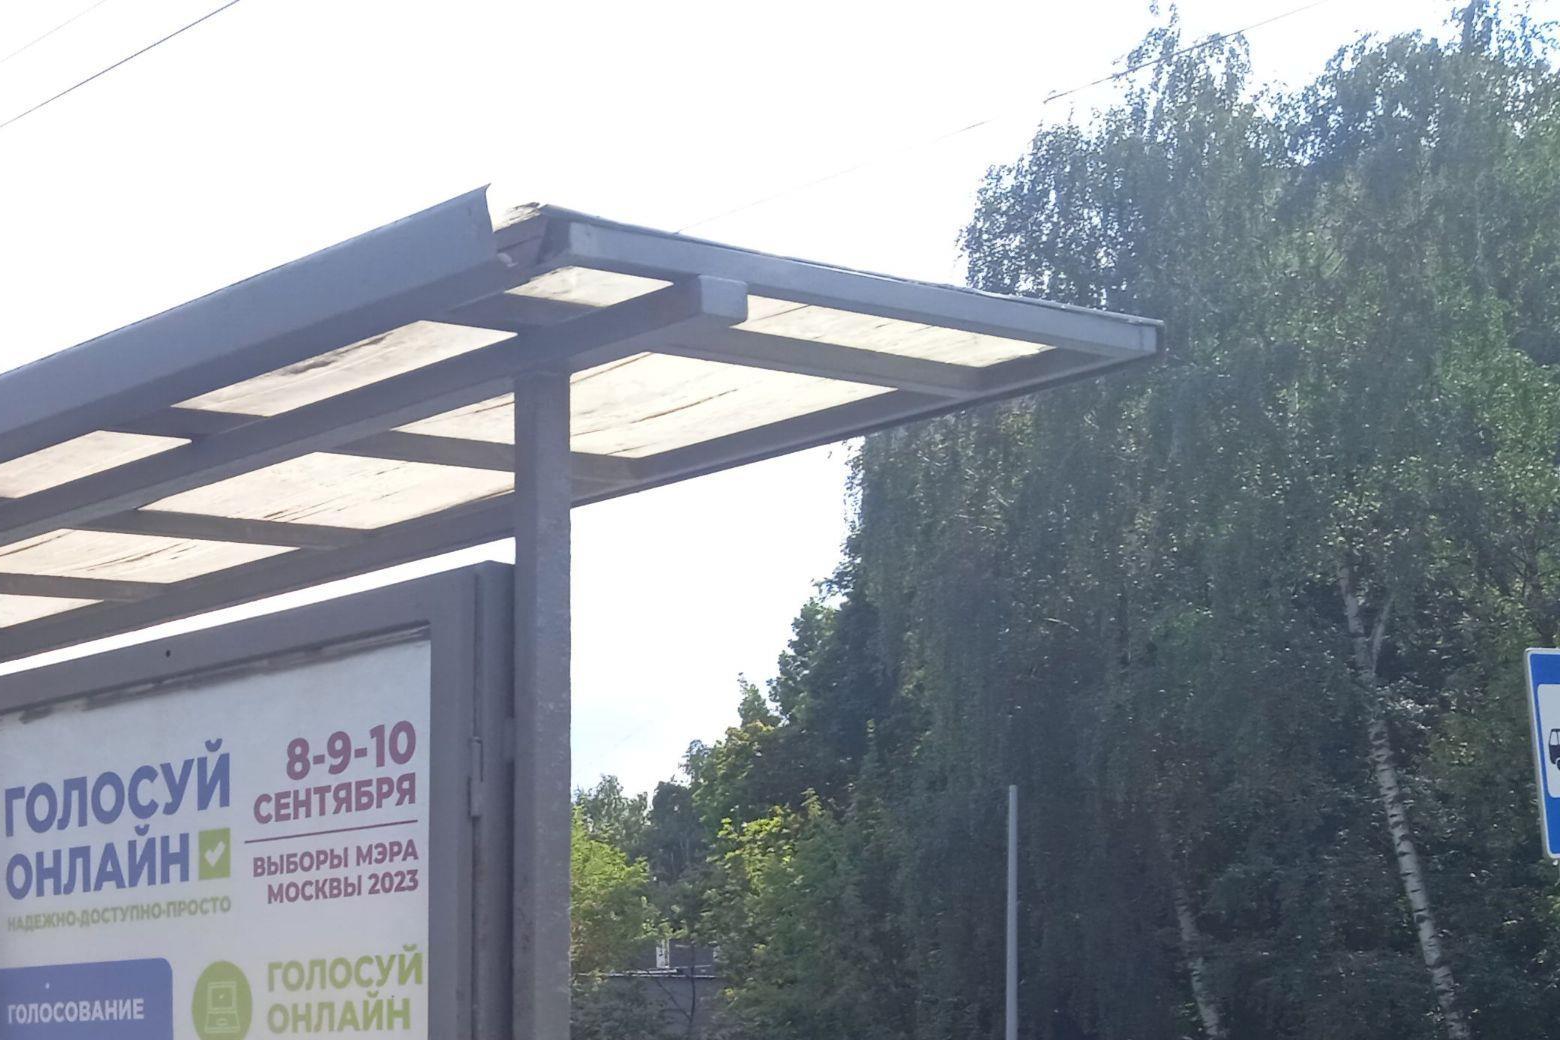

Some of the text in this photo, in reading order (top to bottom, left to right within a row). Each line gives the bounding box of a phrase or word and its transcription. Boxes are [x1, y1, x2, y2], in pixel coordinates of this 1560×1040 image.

[286, 720, 417, 780] 8-9-10
[4, 738, 230, 837] ГОЛОСУЙ
[253, 772, 416, 824] СЕНТЯБРЯ
[6, 824, 189, 900] ОНЛАЙН
[253, 838, 419, 877] ВЫБОРЫ МЭРА
[267, 869, 419, 904] МОСКВЫ 2023
[267, 944, 424, 992] ГОЛОСУЙ
[8, 998, 145, 1024] ГОЛОСОВАНИЕ
[267, 990, 411, 1034] ОНЛАЙН
